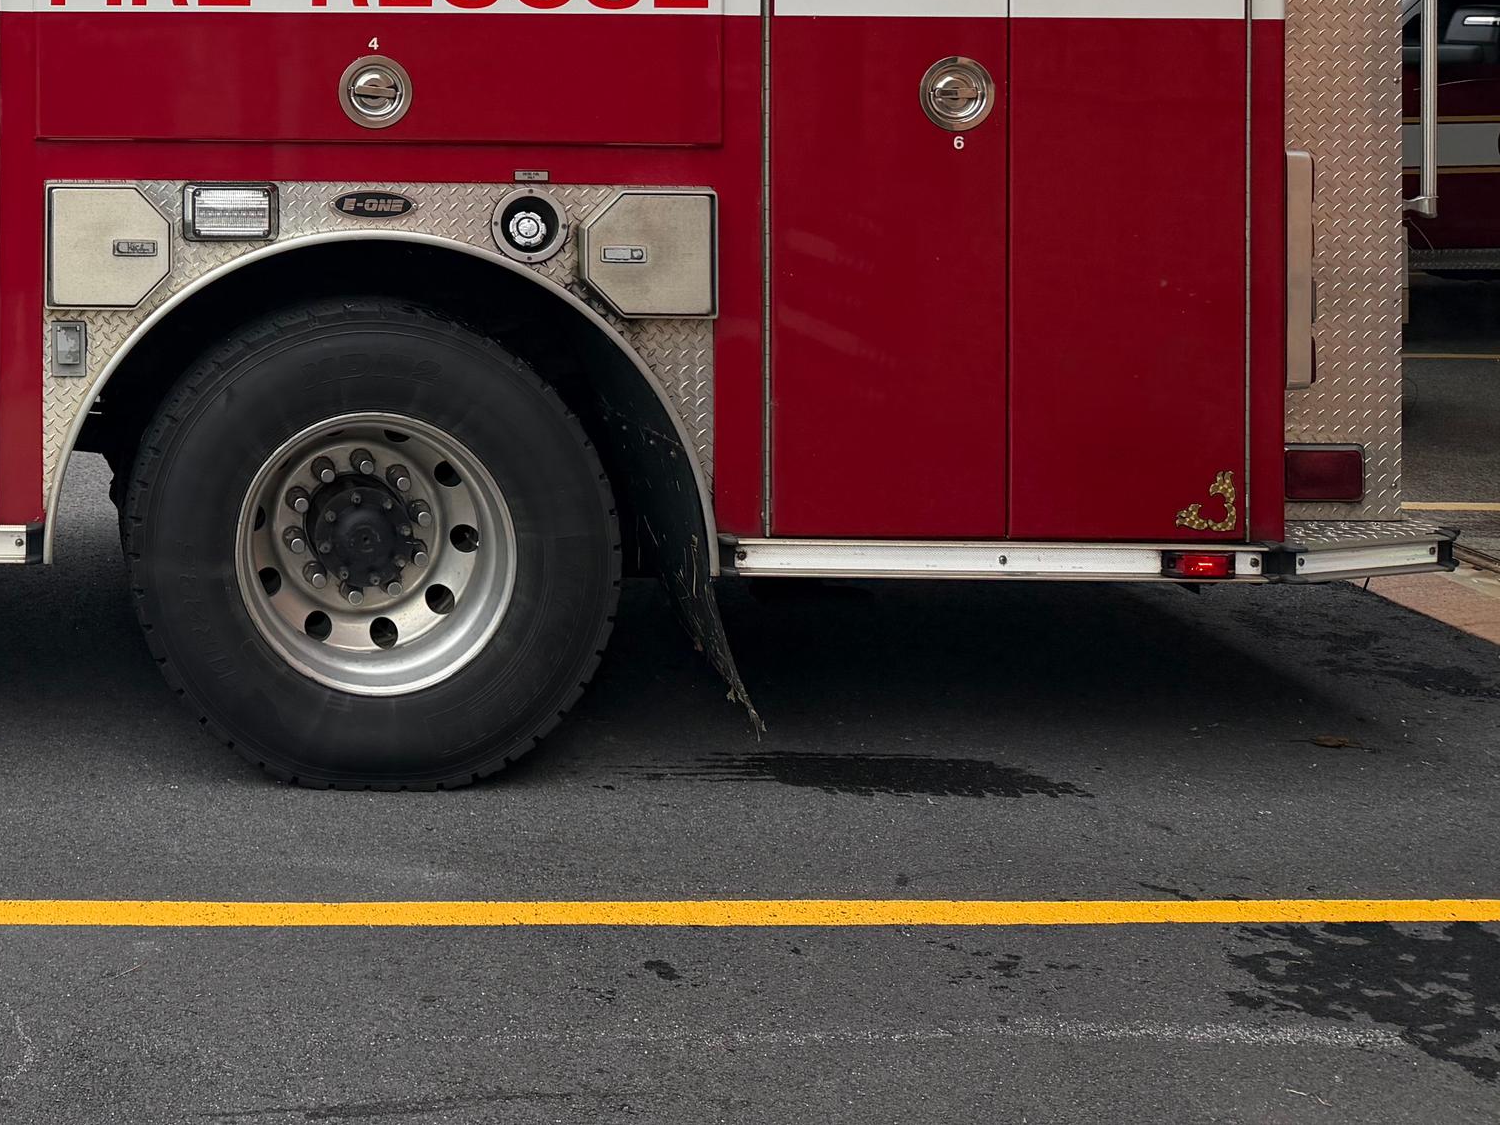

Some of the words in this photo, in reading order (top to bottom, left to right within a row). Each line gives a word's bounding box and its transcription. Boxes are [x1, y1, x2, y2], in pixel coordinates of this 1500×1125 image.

[367, 37, 380, 50] 4
[953, 135, 965, 150] 6
[342, 197, 405, 212] E-ONE
